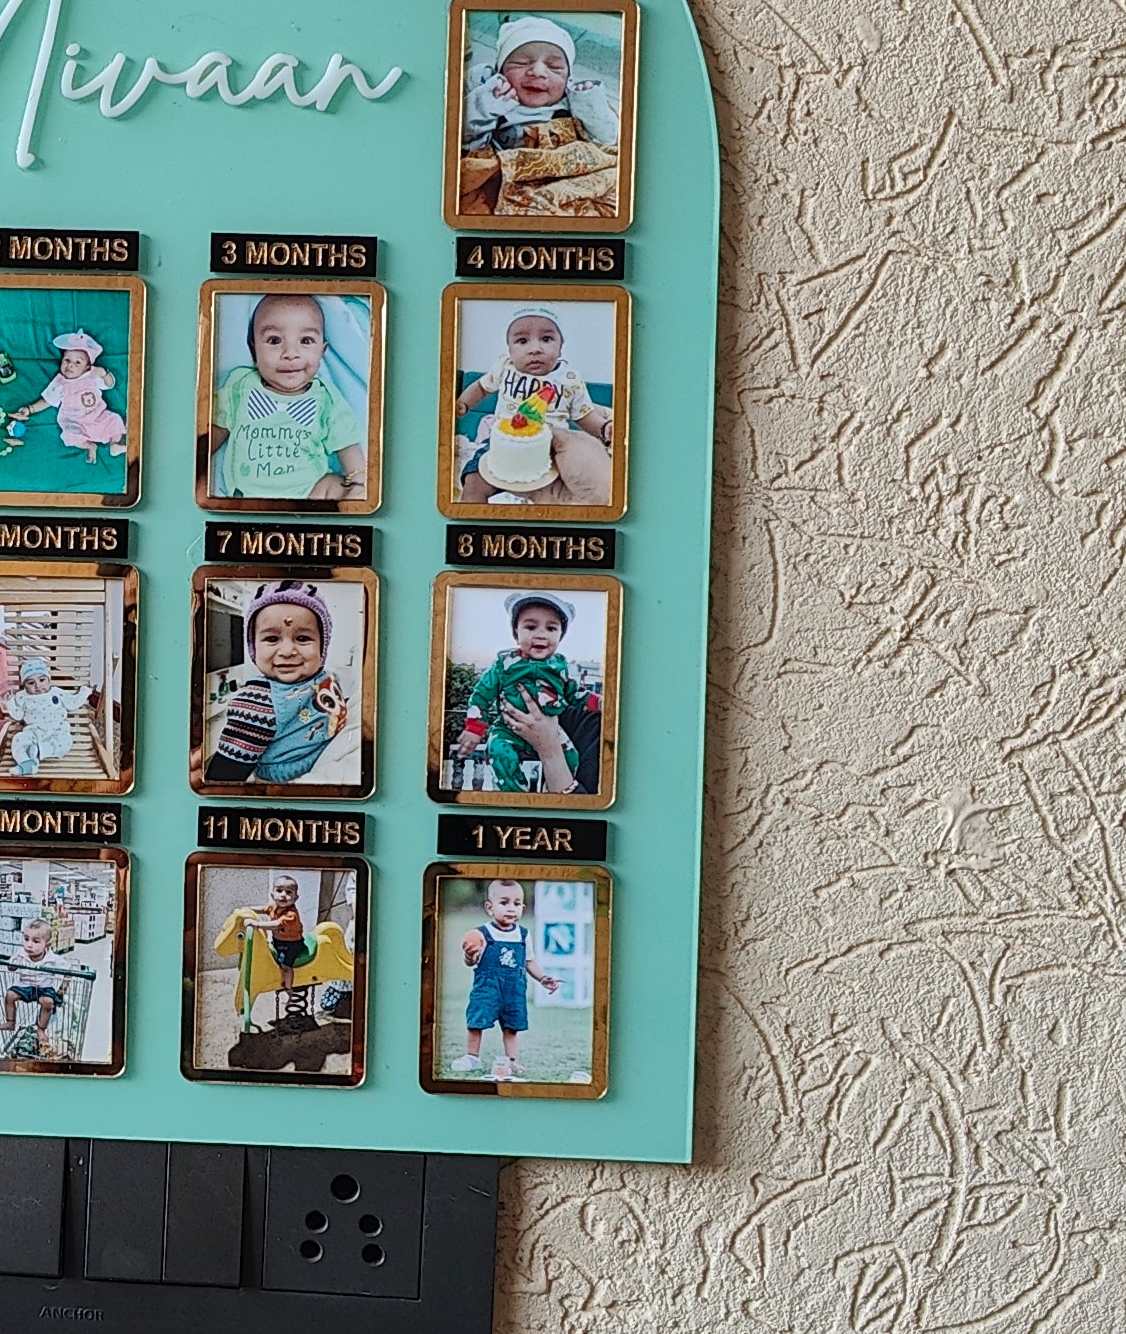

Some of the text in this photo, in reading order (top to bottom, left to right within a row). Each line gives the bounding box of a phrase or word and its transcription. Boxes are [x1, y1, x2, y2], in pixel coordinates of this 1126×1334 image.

[9, 235, 129, 262] MONTHS
[222, 241, 367, 269] 3 MONTHS
[467, 245, 615, 272] 4 MONTHS
[236, 424, 312, 447] Mommy's
[248, 438, 300, 461] Little
[256, 462, 295, 479] Man
[216, 530, 362, 558] 7 MONTHS
[458, 534, 605, 561] 8 MONTHS
[203, 815, 360, 845] 11 MONTHS
[472, 825, 573, 852] 1 YEAR
[38, 1306, 105, 1322] ANCHOR
